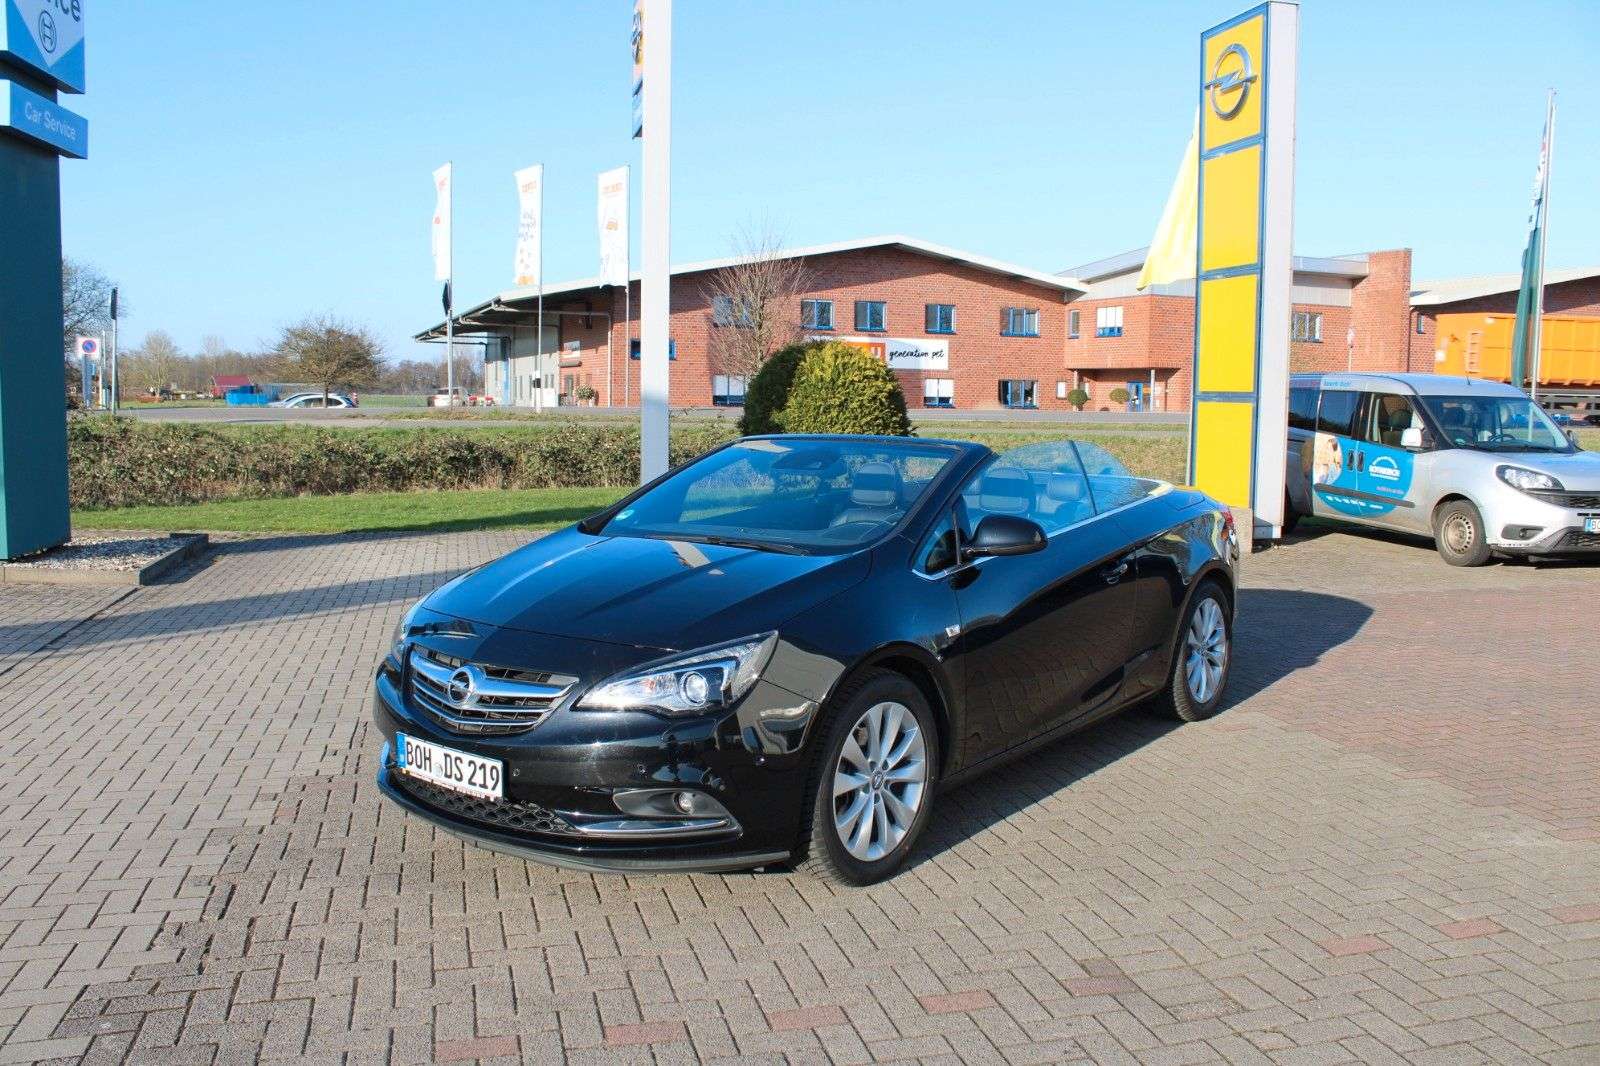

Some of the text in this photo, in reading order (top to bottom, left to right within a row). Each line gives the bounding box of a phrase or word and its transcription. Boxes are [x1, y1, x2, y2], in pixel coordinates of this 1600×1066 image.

[25, 102, 76, 141] Car Service
[406, 741, 500, 791] BOH DS 219
